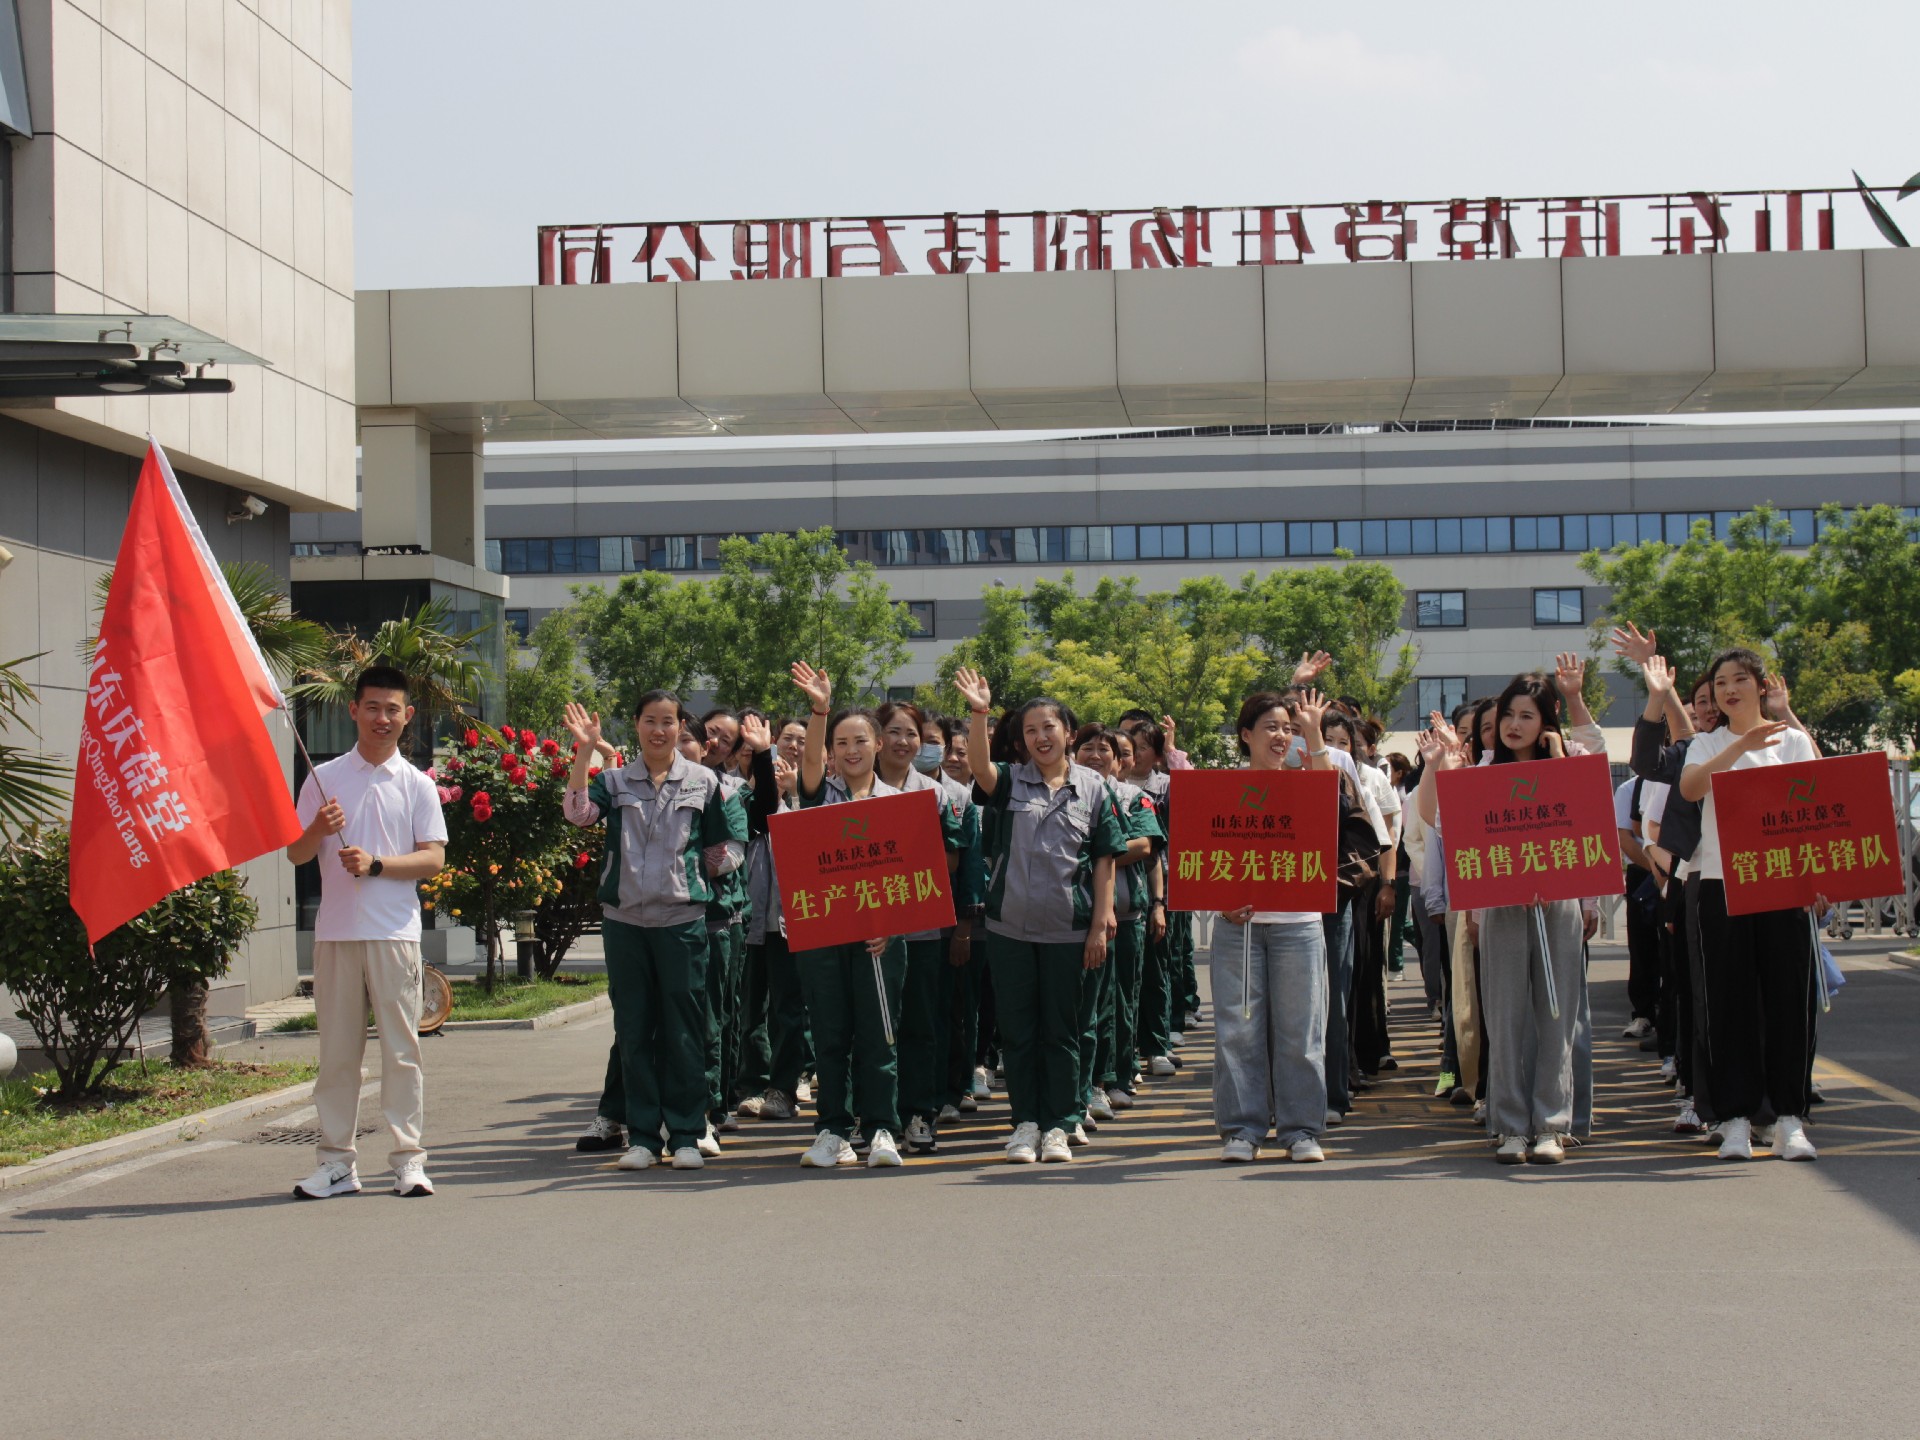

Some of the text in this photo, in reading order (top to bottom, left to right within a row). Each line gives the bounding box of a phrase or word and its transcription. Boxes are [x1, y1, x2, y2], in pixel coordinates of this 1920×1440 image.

[1211, 814, 1293, 830] 山东庆葆堂
[1484, 802, 1568, 826] 山东庆葆堂
[1761, 803, 1846, 827] 山东庆葆堂
[817, 840, 898, 866] 山东庆葆堂
[1177, 849, 1328, 883] 研发先锋队
[1454, 834, 1612, 881] 销售先锋队
[1731, 834, 1890, 885] 管理先锋队
[791, 868, 942, 921] 生产先锋队
